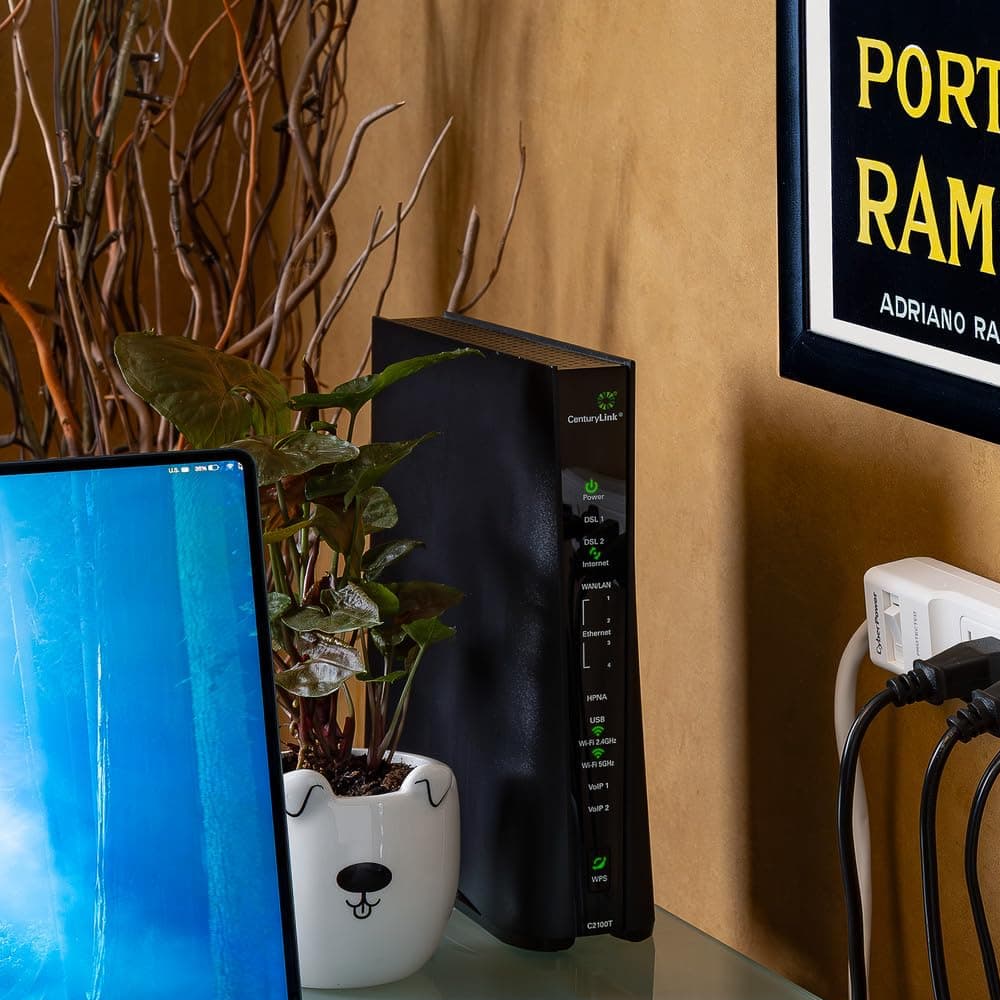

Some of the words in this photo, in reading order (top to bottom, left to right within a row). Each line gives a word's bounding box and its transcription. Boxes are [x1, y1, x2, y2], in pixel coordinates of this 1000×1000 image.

[880, 292, 966, 334] ADRIANO
[583, 493, 605, 501] Power
[584, 538, 599, 546] DSL
[582, 560, 609, 568] Internet
[581, 581, 611, 590] WAN/LAN
[582, 629, 611, 638] Ethernet
[586, 693, 608, 702] HPNA
[589, 716, 606, 724] USB
[578, 739, 594, 747] Wi-Fi
[595, 737, 617, 746] 2.4GHz
[581, 761, 597, 769] Wi-Fi
[598, 760, 615, 769] 5GHz
[588, 782, 604, 791] VoIP
[588, 805, 604, 813] VoIP
[591, 875, 608, 883] WPS
[587, 919, 613, 930] C2100T
